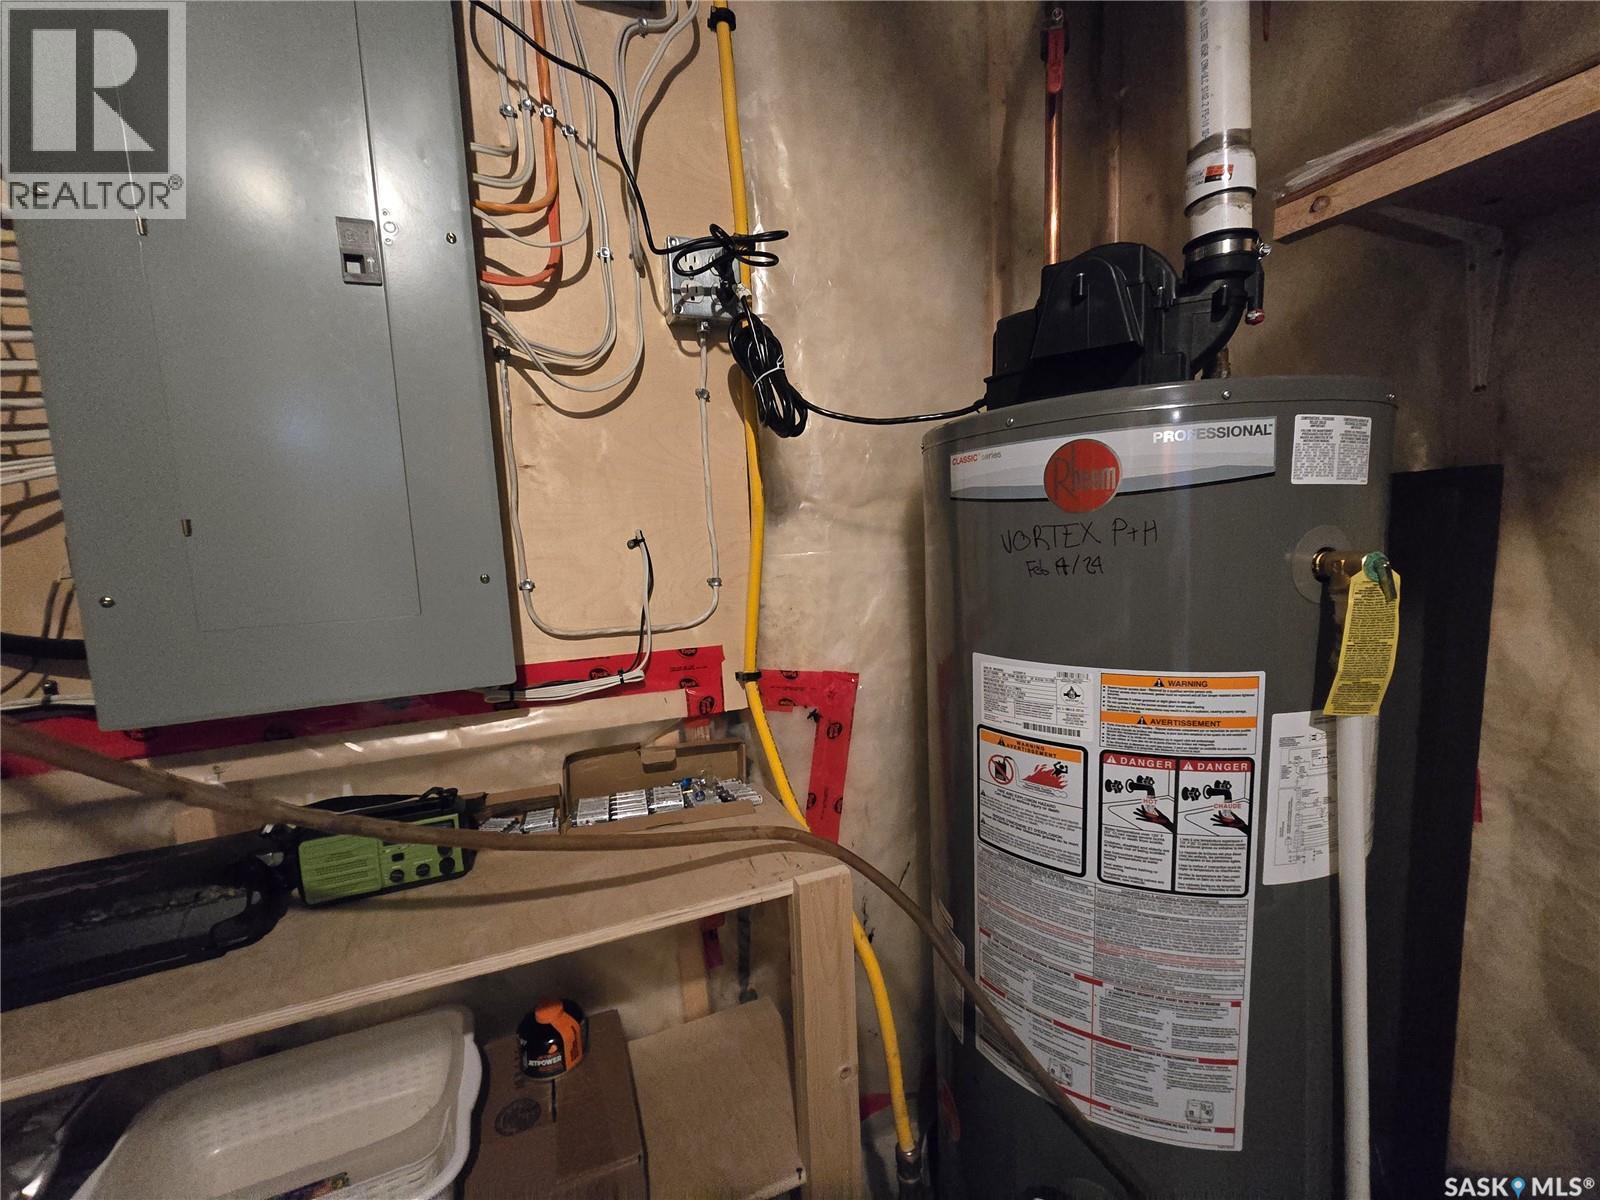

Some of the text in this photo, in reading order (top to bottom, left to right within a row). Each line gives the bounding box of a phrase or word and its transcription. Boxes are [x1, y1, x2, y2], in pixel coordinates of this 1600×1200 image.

[1053, 444, 1116, 501] Rheem
[1000, 520, 1102, 554] VORTEX
[1167, 680, 1209, 688] WARNING
[1150, 718, 1222, 727] AVERTISSEMENT
[1015, 740, 1045, 751] WARNING
[1119, 757, 1173, 769] DANGER
[1196, 762, 1249, 771] DANGER
[528, 1055, 562, 1067] JETPOWER
